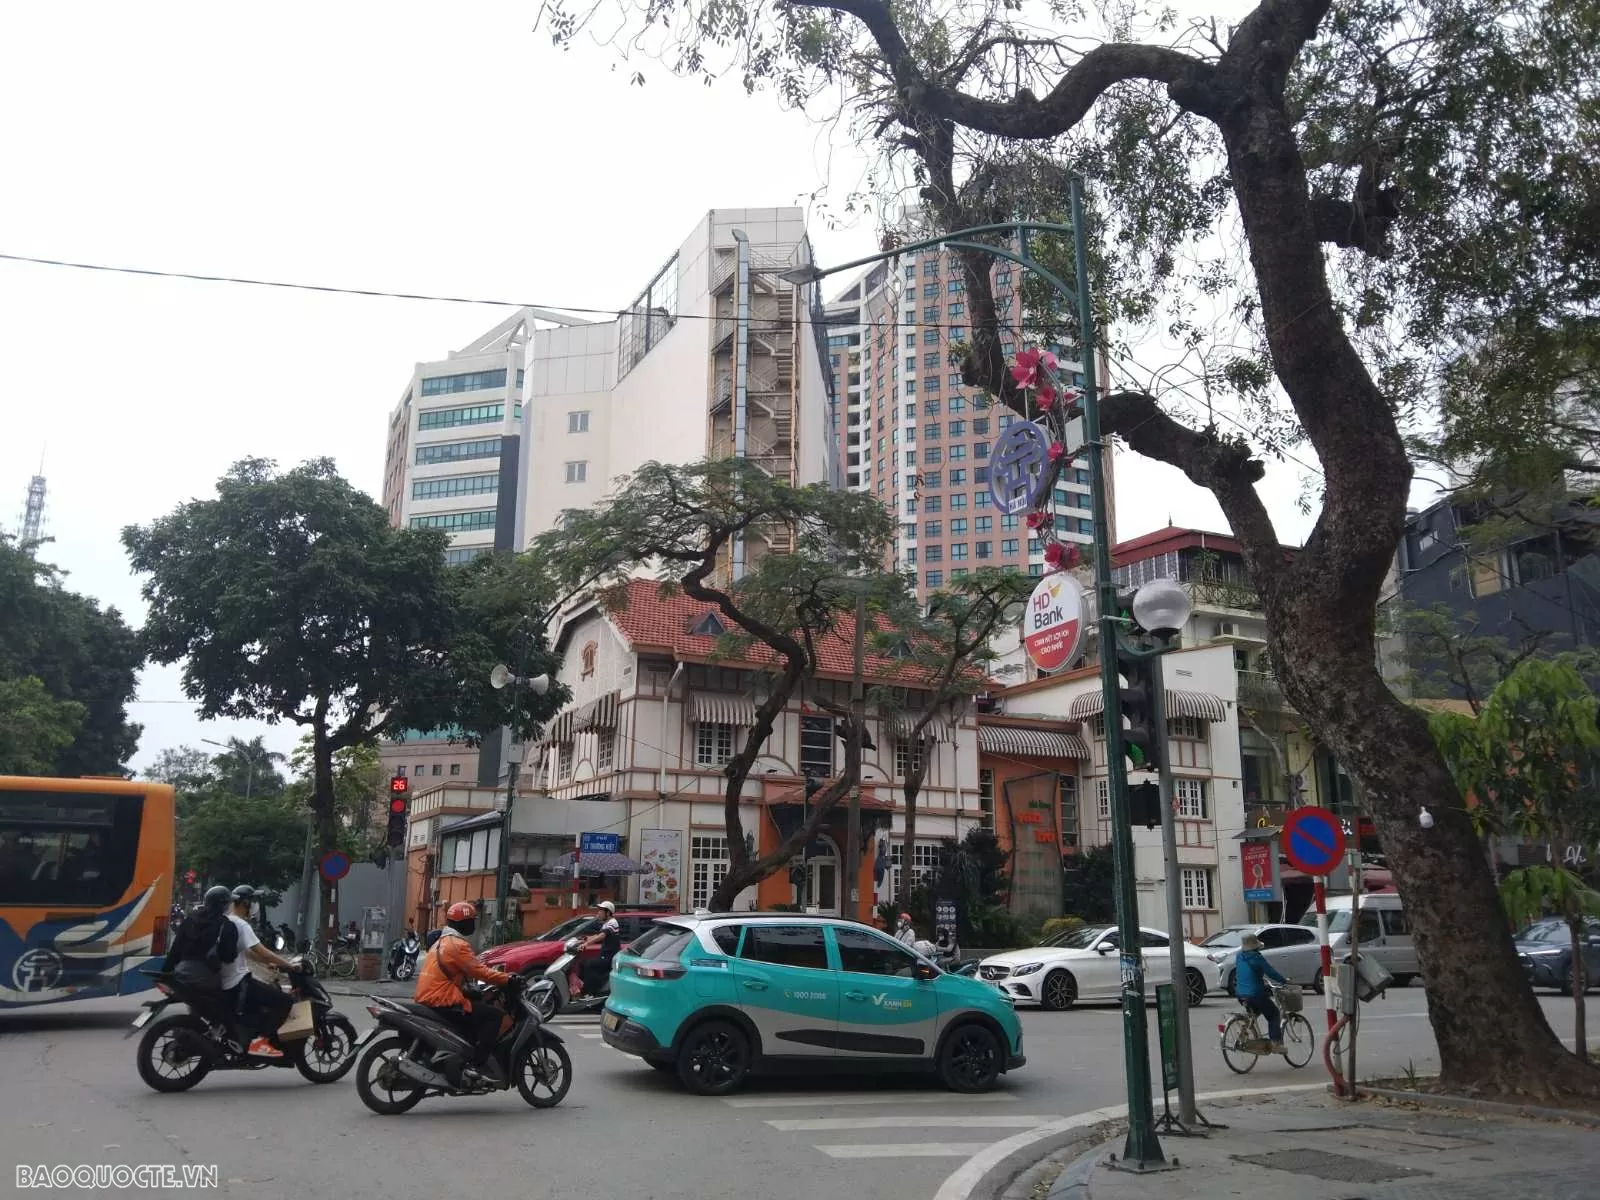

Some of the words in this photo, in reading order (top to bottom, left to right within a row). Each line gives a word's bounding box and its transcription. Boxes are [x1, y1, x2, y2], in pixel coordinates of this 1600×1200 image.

[1033, 592, 1050, 612] HD
[1034, 605, 1063, 630] Bank
[393, 780, 405, 790] 26
